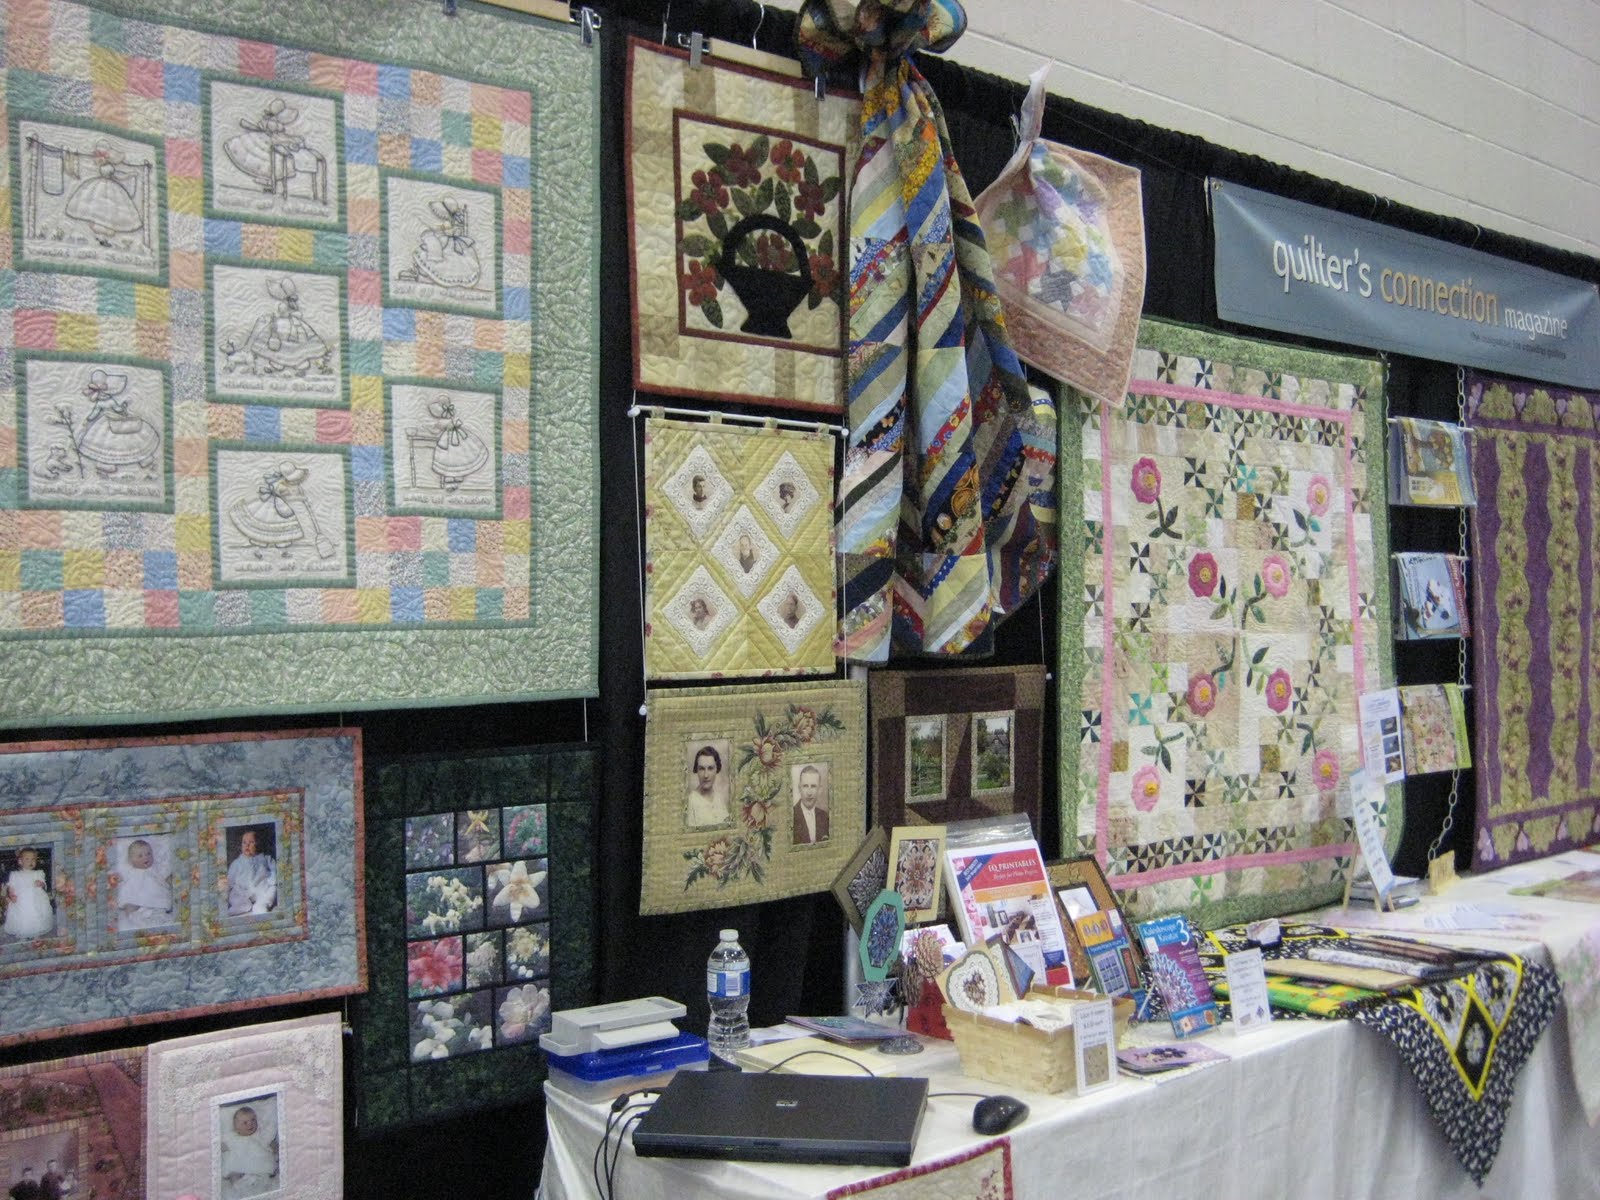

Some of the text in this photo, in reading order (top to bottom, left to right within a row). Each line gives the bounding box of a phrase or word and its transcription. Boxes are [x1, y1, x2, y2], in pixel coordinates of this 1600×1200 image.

[1272, 234, 1568, 340] quilter's connection magazine
[999, 859, 1037, 871] PRINTABLES
[1176, 919, 1190, 946] 3
